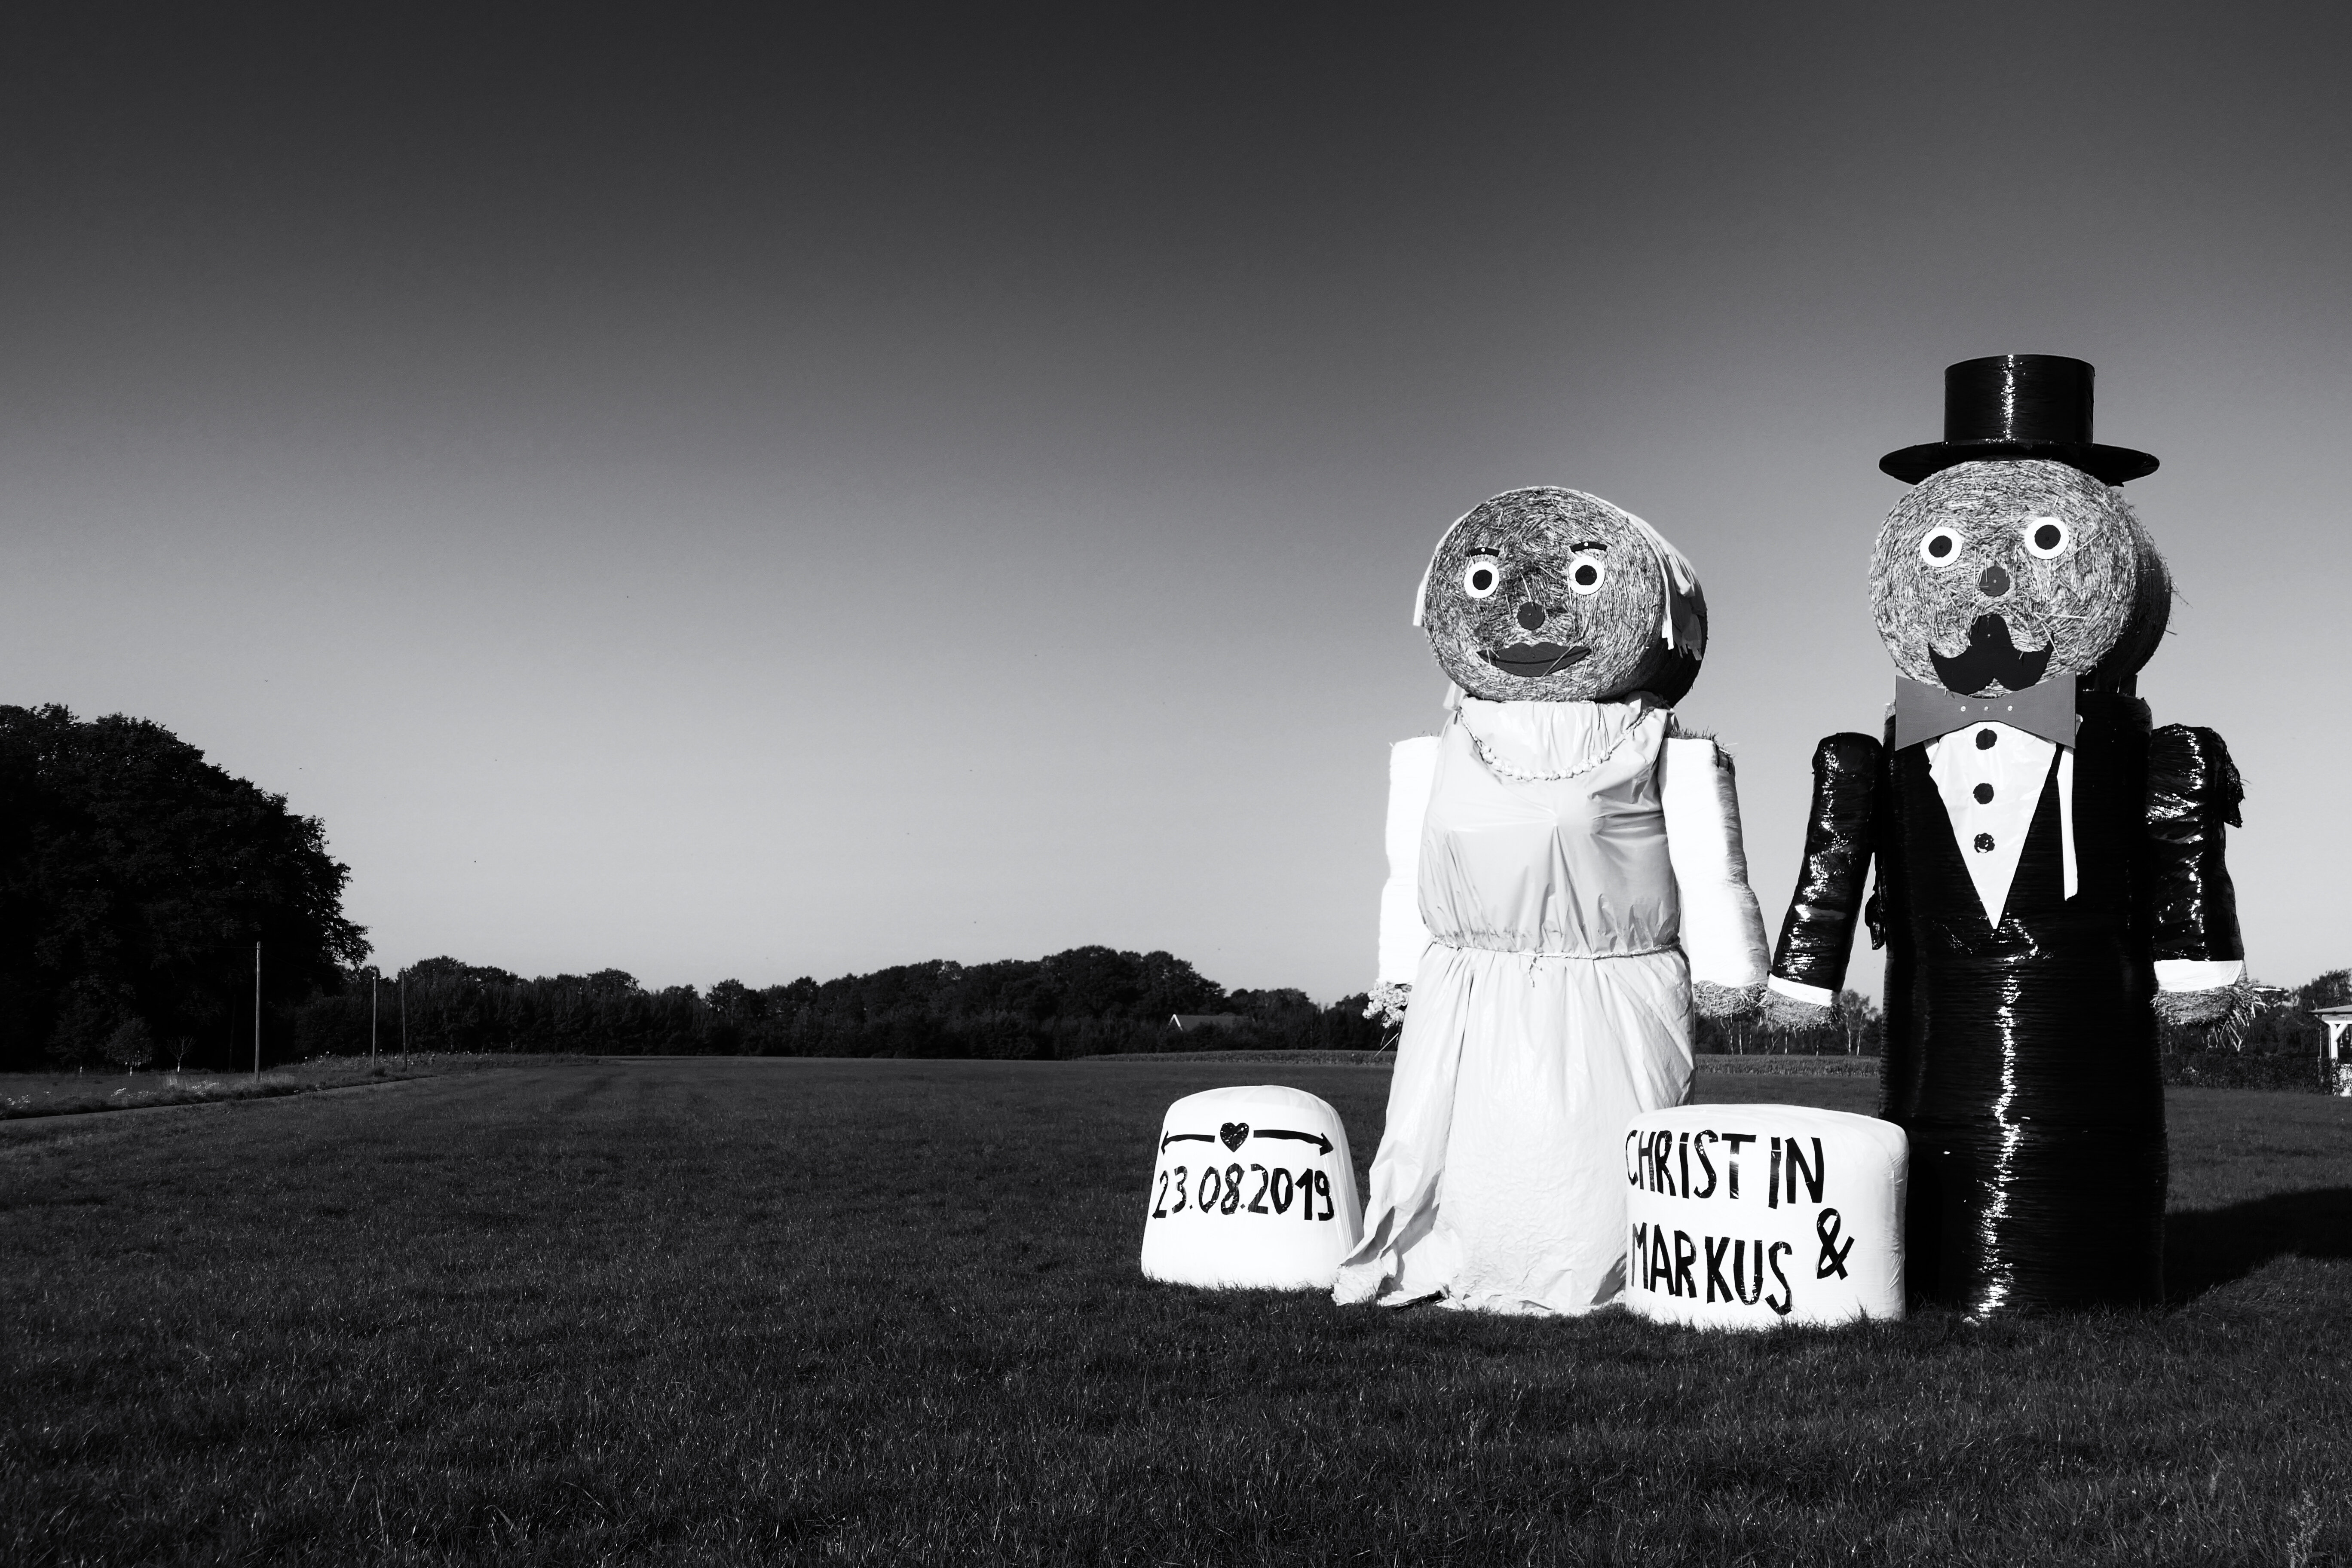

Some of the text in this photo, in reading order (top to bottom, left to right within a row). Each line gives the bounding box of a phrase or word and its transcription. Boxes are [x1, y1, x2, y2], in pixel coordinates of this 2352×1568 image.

[1152, 1163, 1334, 1221] 23.08.2019
[1631, 1208, 1855, 1315] MARKUS &
